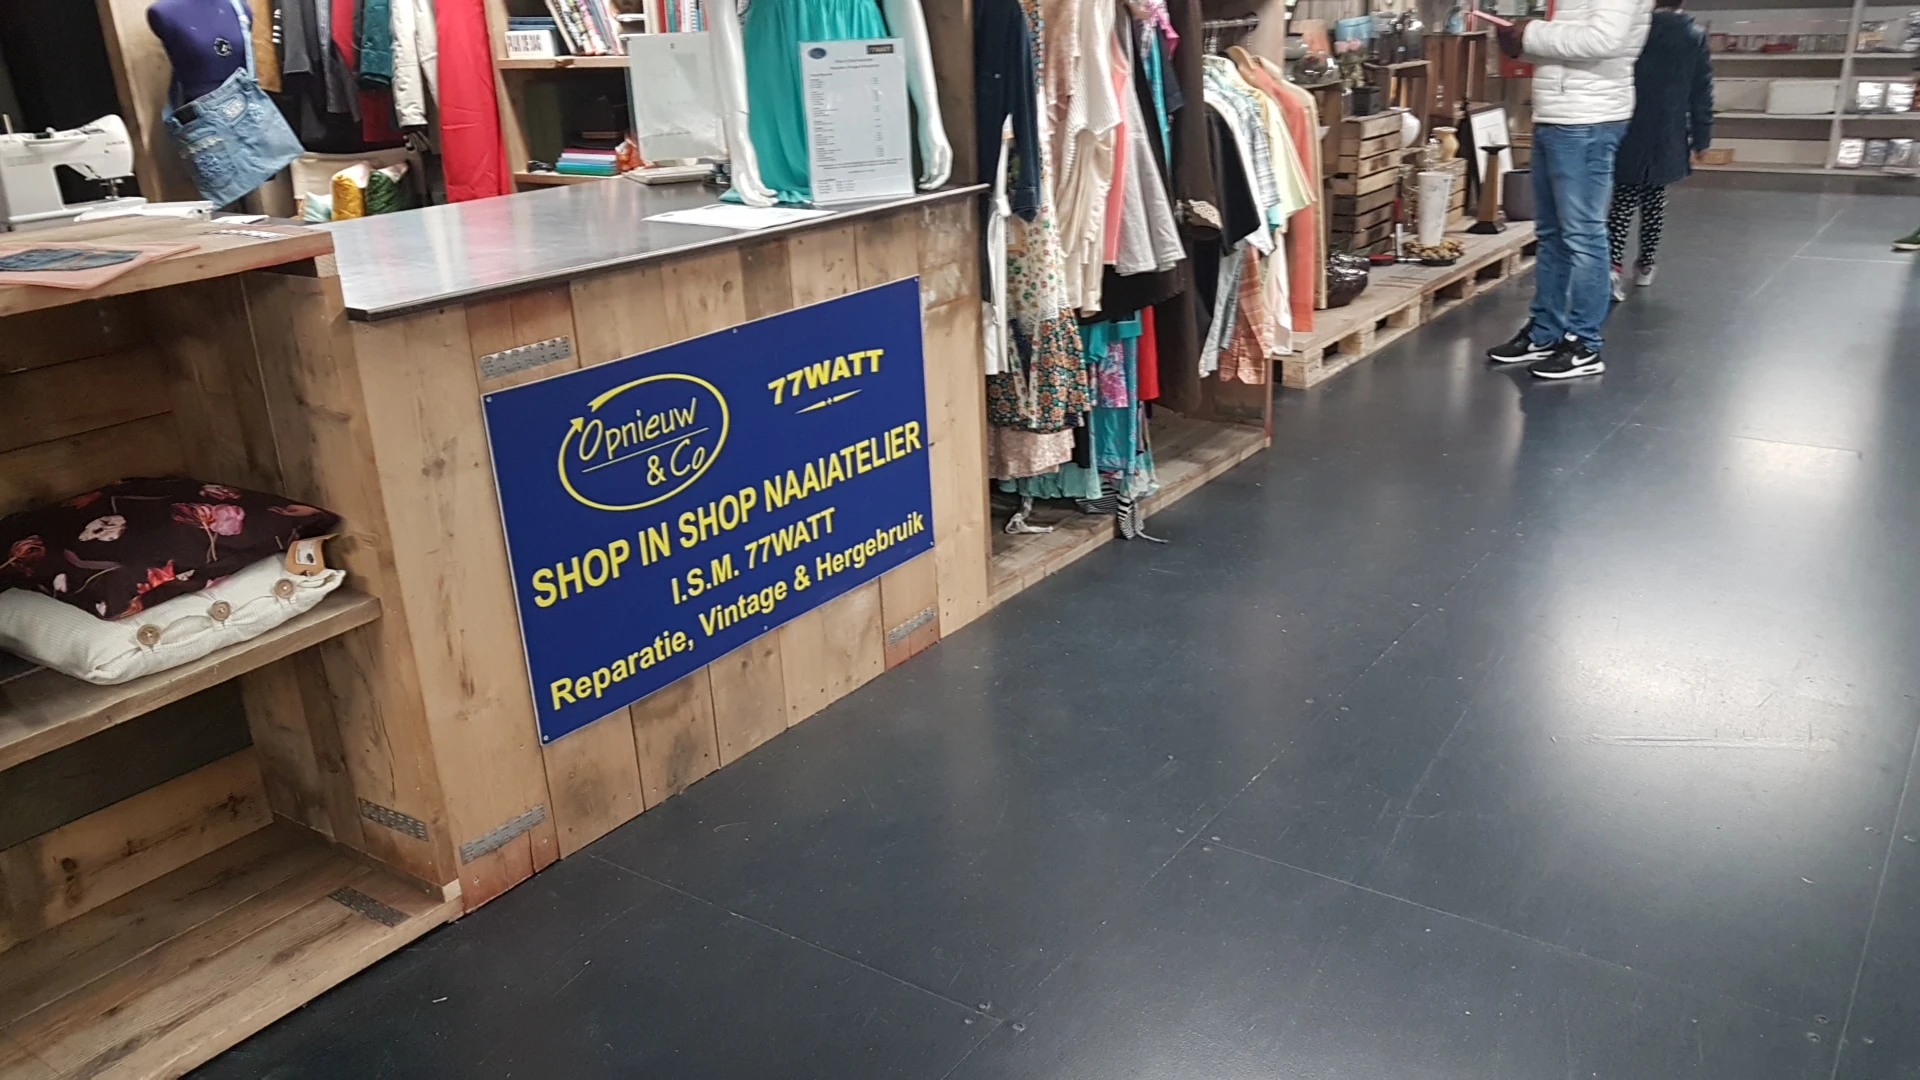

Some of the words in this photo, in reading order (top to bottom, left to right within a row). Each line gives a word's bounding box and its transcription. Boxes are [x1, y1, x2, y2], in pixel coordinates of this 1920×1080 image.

[768, 349, 885, 405] 77WATT
[577, 396, 698, 461] Opnieuw
[646, 455, 667, 486] &
[671, 438, 707, 478] Co
[532, 539, 632, 608] SHOP
[638, 525, 672, 568] IN
[678, 487, 758, 549] SHOP
[764, 421, 923, 513] NAAIATELIER
[671, 560, 740, 605] I.S.M.
[744, 507, 836, 569] 77WATT
[549, 629, 695, 711] Reparatie,
[697, 580, 788, 638] Vintage
[793, 565, 812, 592] &
[816, 511, 925, 581] Hergebruik
